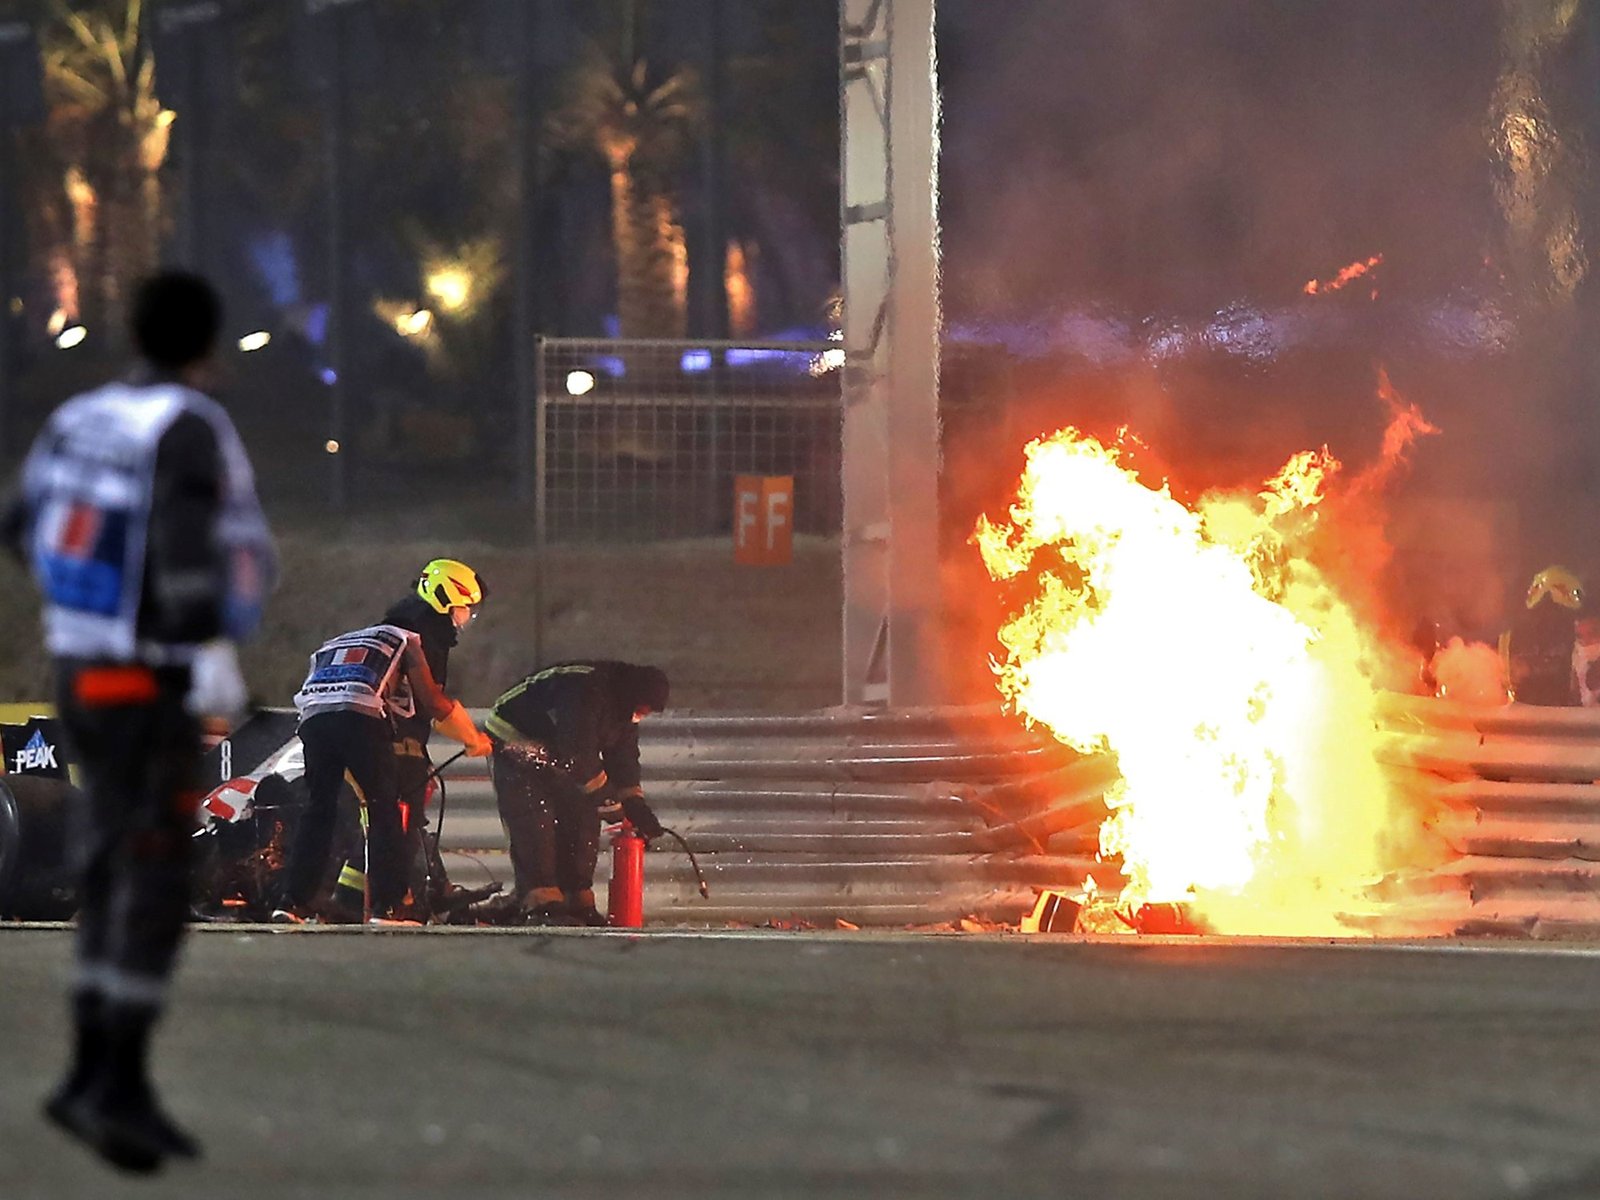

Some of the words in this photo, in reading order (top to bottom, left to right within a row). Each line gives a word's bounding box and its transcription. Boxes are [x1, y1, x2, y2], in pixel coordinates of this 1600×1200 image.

[301, 684, 347, 696] BAHRAIN
[9, 745, 58, 774] PEAK
[221, 739, 232, 781] 8
